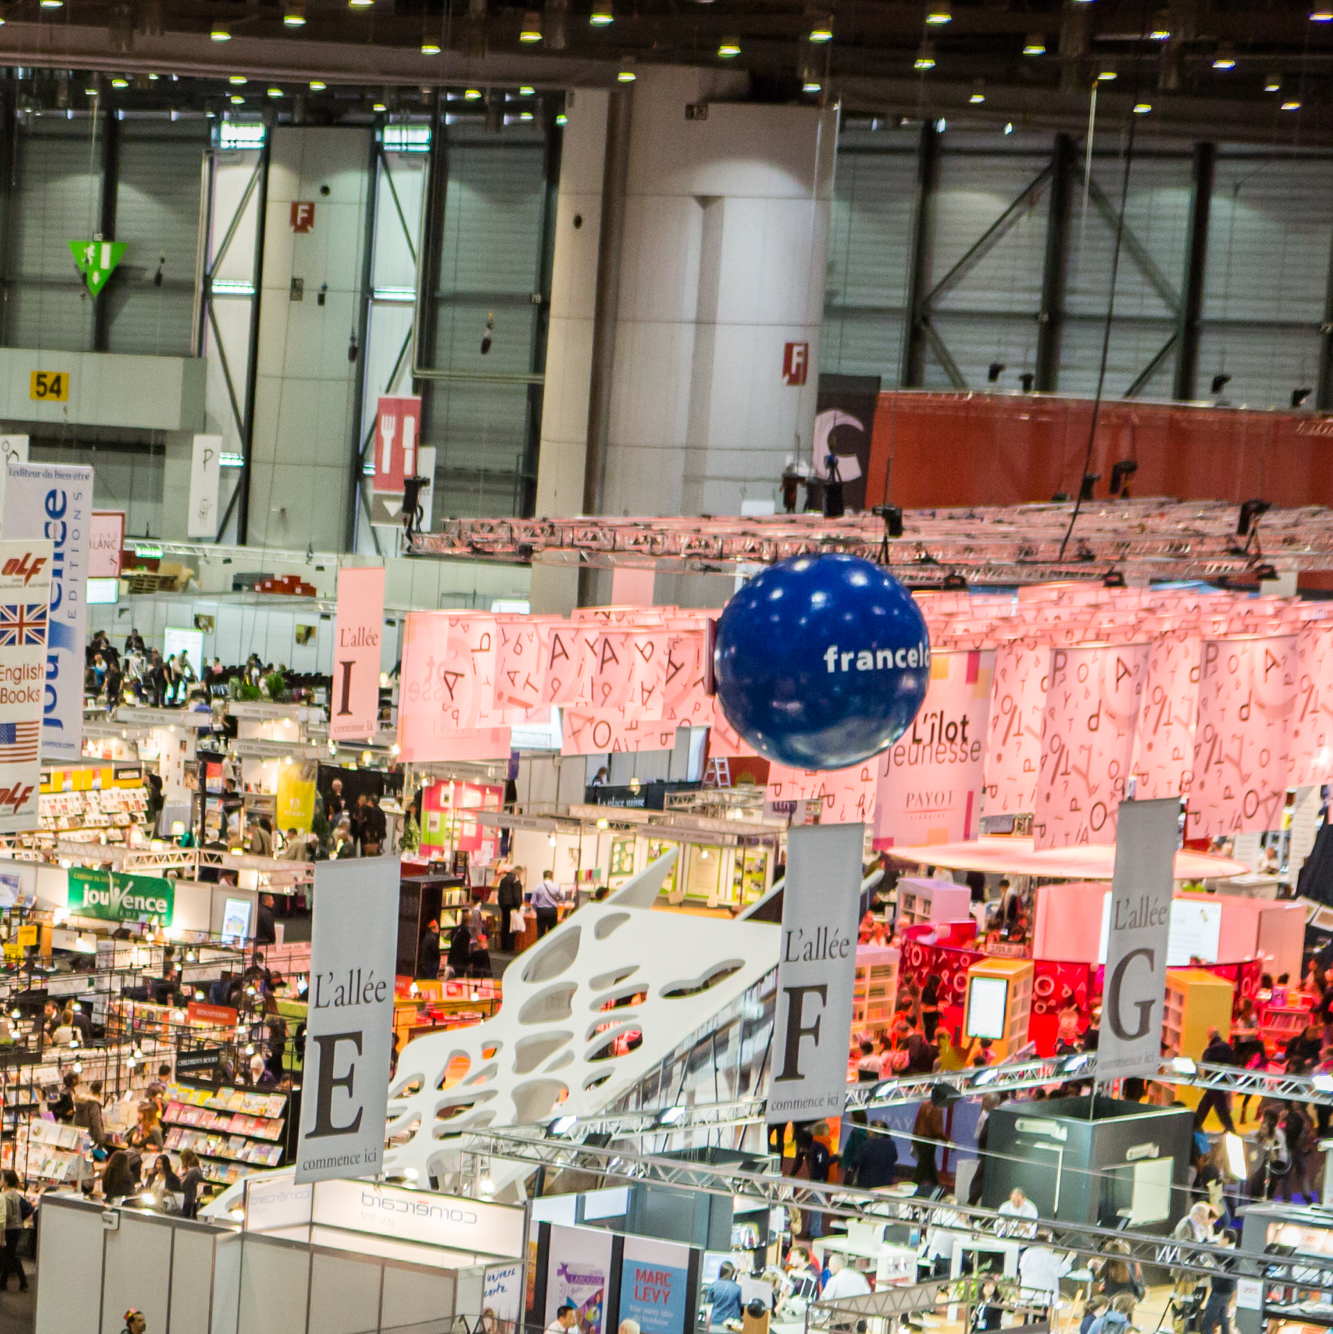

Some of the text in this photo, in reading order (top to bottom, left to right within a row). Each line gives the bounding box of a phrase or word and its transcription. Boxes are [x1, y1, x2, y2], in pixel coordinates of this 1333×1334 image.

[297, 205, 309, 226] F
[791, 345, 805, 370] F
[35, 373, 62, 399] 54
[339, 627, 380, 649] L'allée
[0, 686, 41, 705] Books
[905, 790, 955, 808] PAYOT
[1112, 895, 1167, 931] L'allée
[785, 928, 850, 963] L'allée
[315, 968, 387, 1010] L'allée
[1107, 947, 1157, 1042] G
[774, 983, 829, 1084] F
[305, 1030, 363, 1140] E
[770, 1094, 839, 1112] commence ici
[302, 1148, 377, 1171] commence ici
[635, 1268, 673, 1288] MARC
[634, 1285, 671, 1305] LEVY
